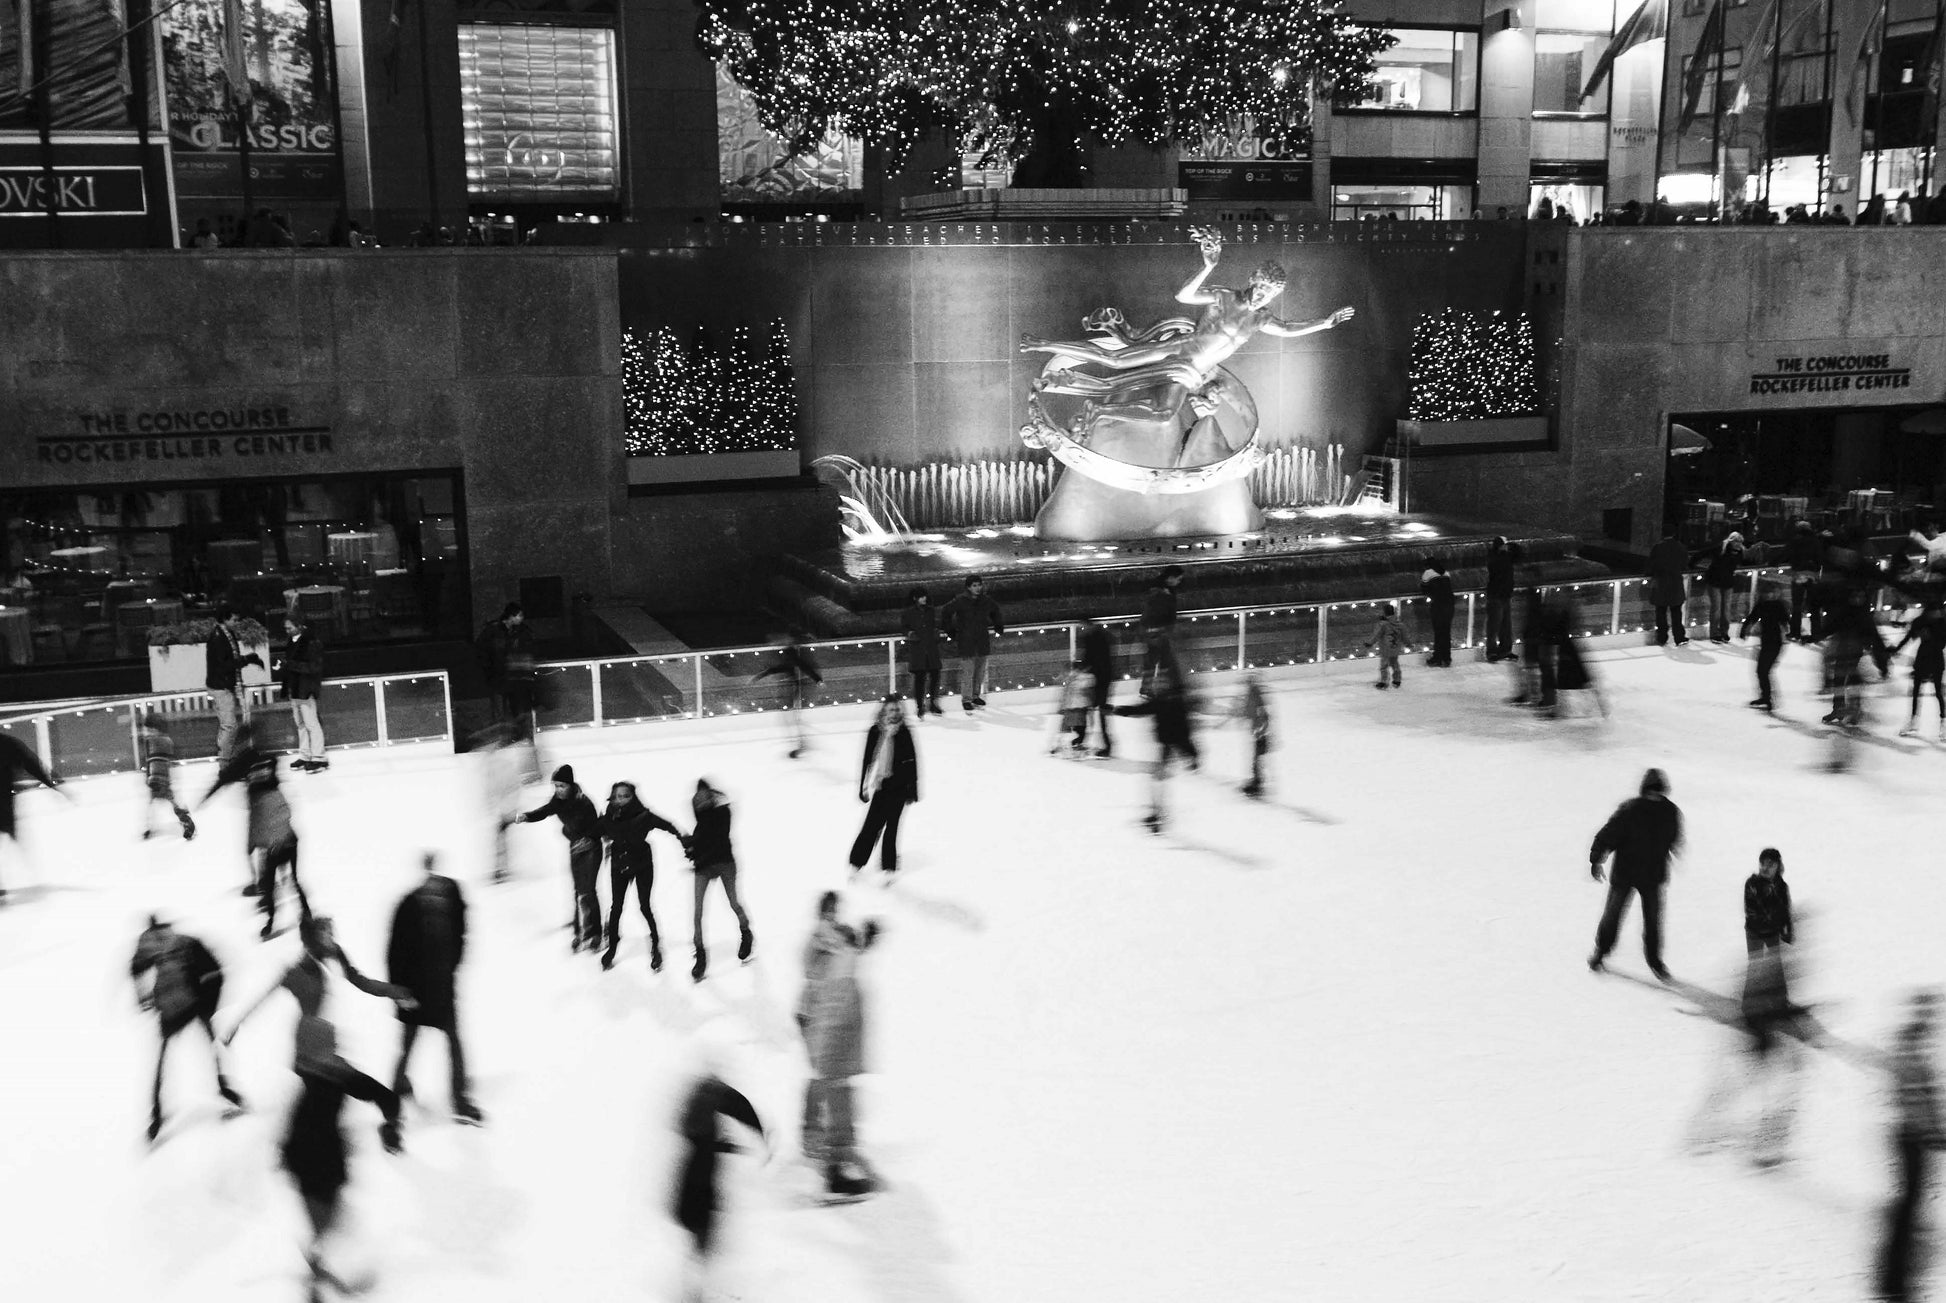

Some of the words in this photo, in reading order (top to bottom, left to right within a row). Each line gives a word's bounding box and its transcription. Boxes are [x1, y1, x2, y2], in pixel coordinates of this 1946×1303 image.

[190, 123, 331, 149] CLASSIC
[887, 224, 998, 234] TEACHER
[1076, 224, 1149, 234] EVERY
[1776, 357, 1803, 373] THE
[1806, 353, 1890, 372] CONCOURSE
[1751, 376, 1850, 395] ROCKEFELLER
[1855, 373, 1910, 390] CENTER
[79, 413, 129, 434] THE
[136, 406, 290, 433] CONCOURSE
[36, 437, 223, 464] ROCKEFELLER
[233, 434, 333, 456] CENTER
